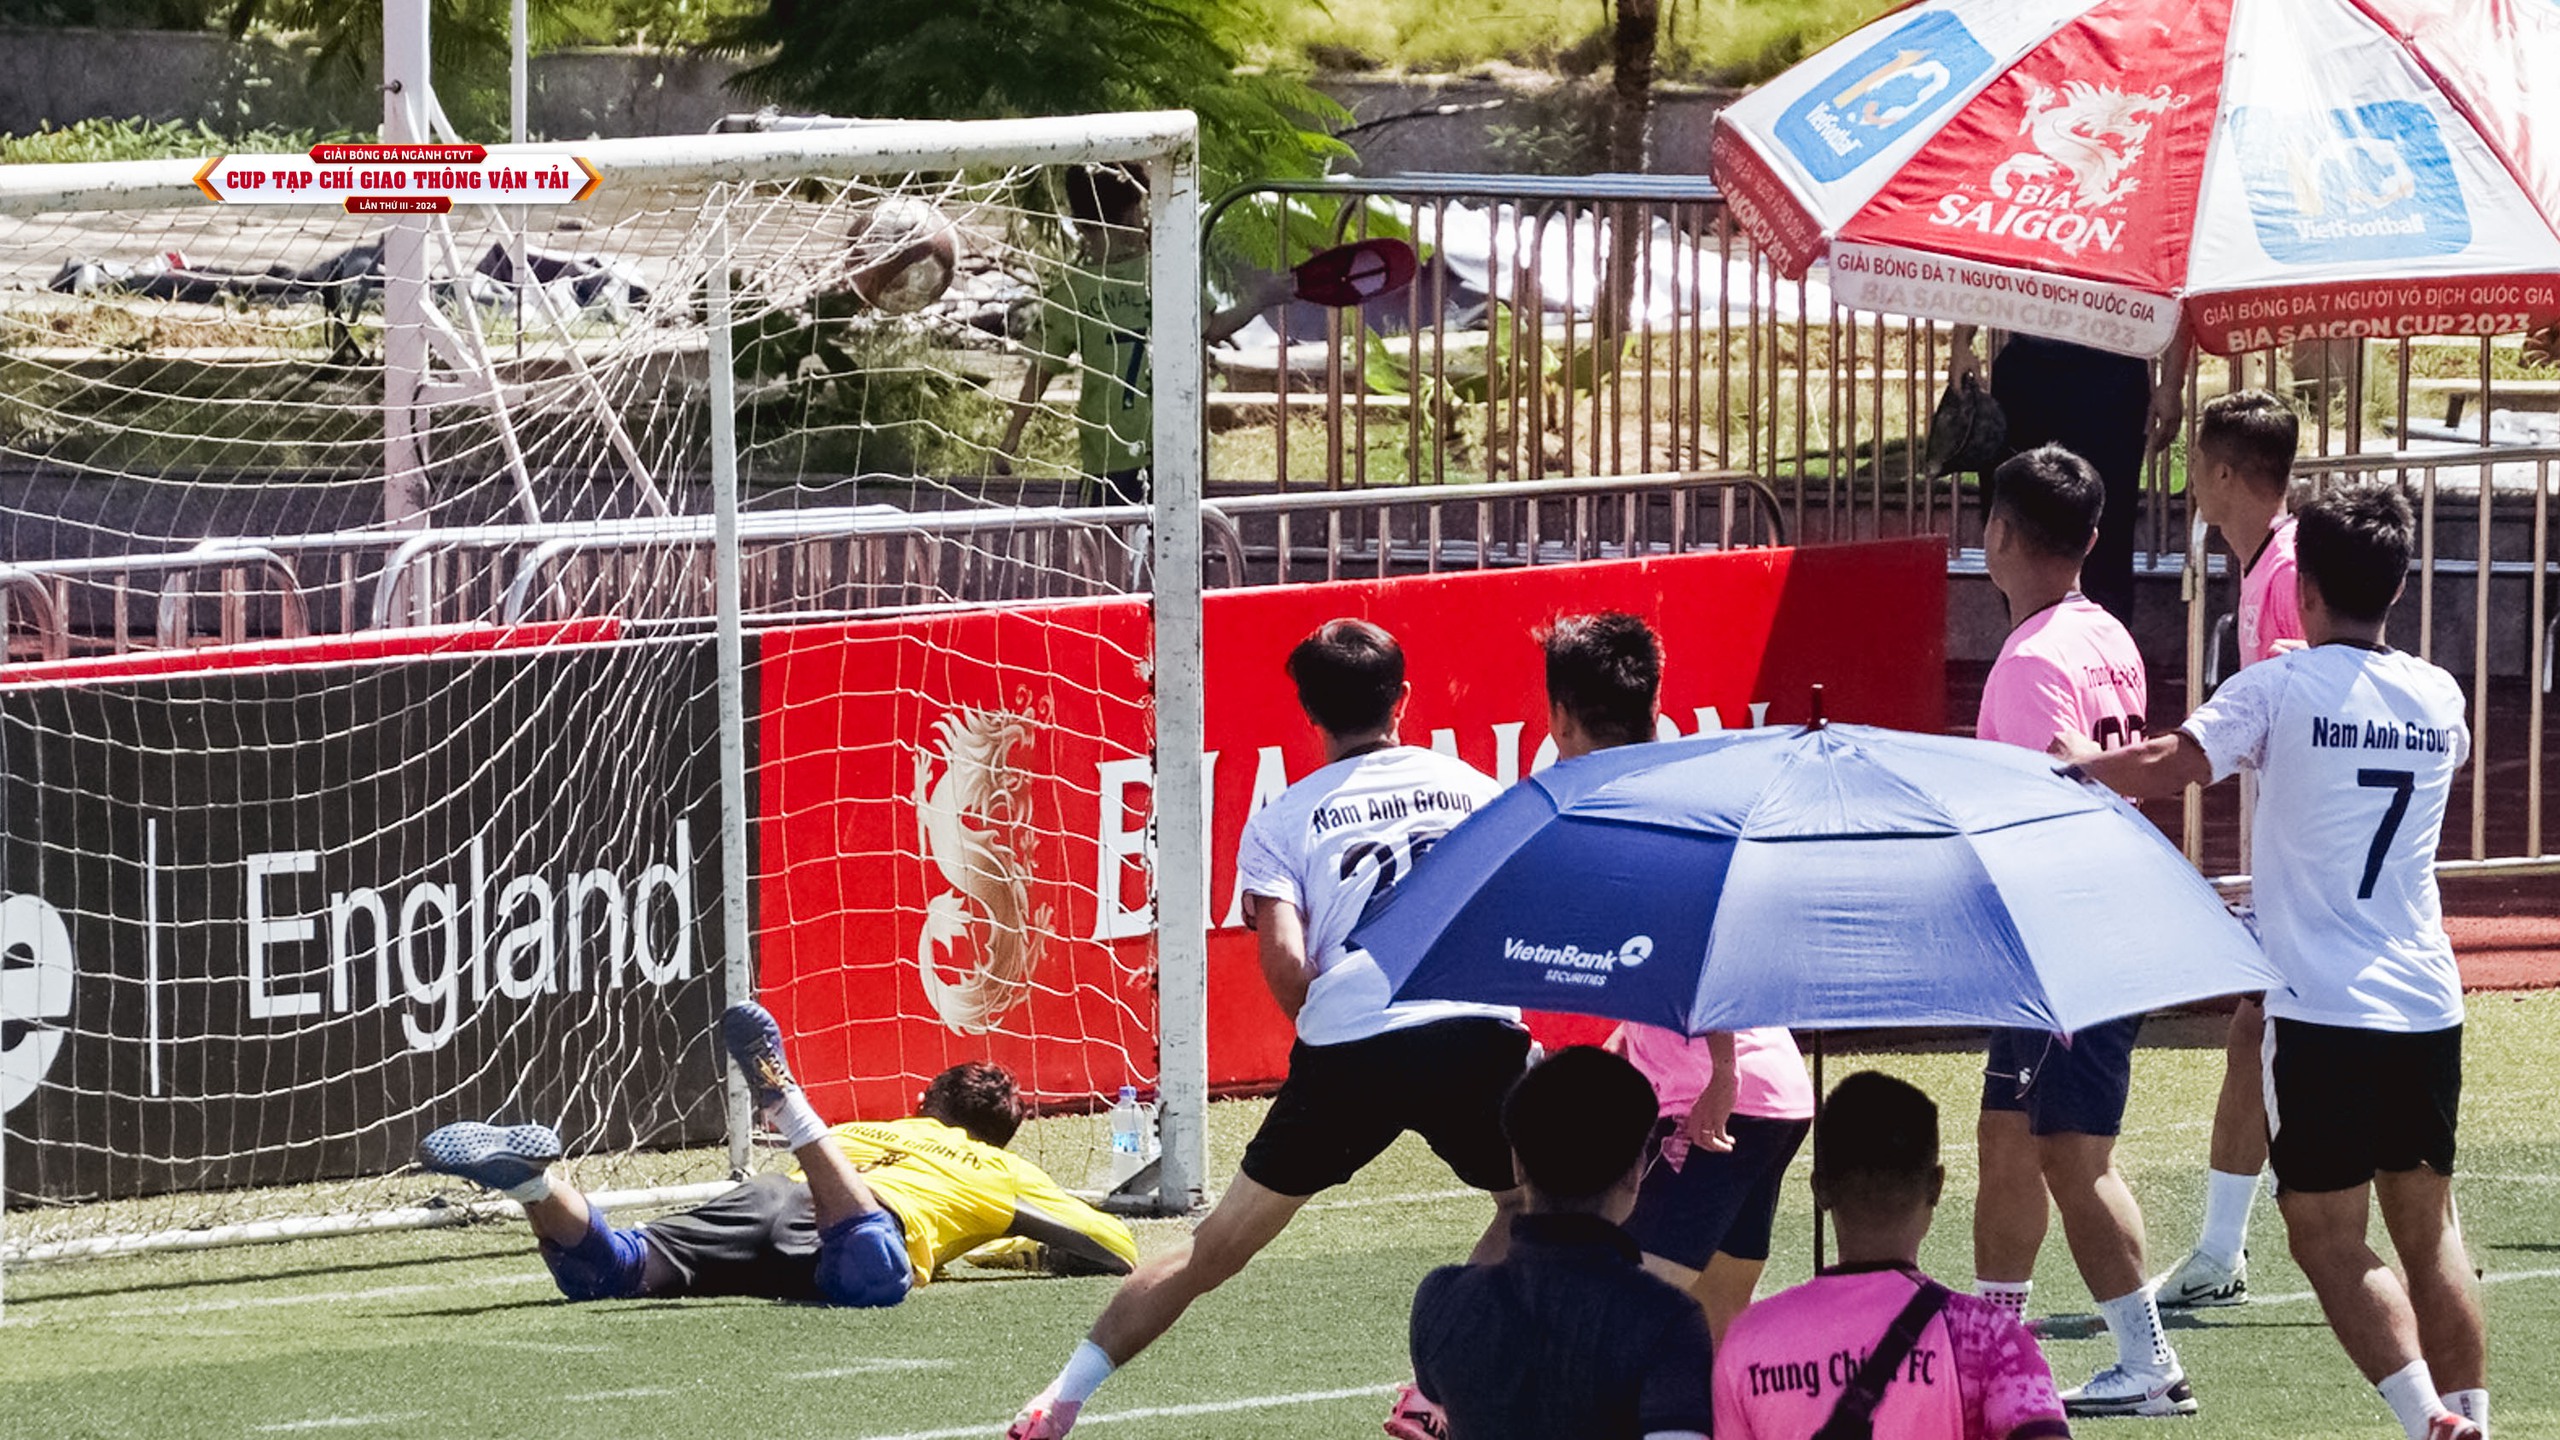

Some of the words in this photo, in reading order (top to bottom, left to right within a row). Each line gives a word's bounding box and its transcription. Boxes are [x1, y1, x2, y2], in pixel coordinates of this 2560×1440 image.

[1928, 193, 2126, 256] SAIGON
[1873, 255, 1918, 279] BÓNG
[1948, 267, 1956, 282] 7
[2130, 301, 2155, 324] GIA
[2238, 297, 2289, 319] BÓNG
[2321, 295, 2330, 311] 7
[2524, 287, 2555, 305] GIA
[2020, 303, 2073, 329] CUP
[2226, 326, 2274, 353] BIA
[2277, 317, 2392, 345] SAIGON
[2395, 313, 2455, 335] CUP
[2458, 312, 2530, 335] 2023
[1106, 328, 1147, 410] 7
[2312, 717, 2358, 748] Nam
[2363, 720, 2399, 749] Anh
[1313, 803, 1361, 834] Nam
[1367, 793, 1408, 821] Anh
[1413, 789, 1472, 814] Group
[2357, 769, 2415, 899] 7
[246, 818, 694, 1053] England
[1504, 937, 1617, 971] VietinBank
[1545, 969, 1607, 986] SECURITIES
[1748, 1361, 1820, 1398] Trung
[1909, 1350, 1936, 1385] FC
